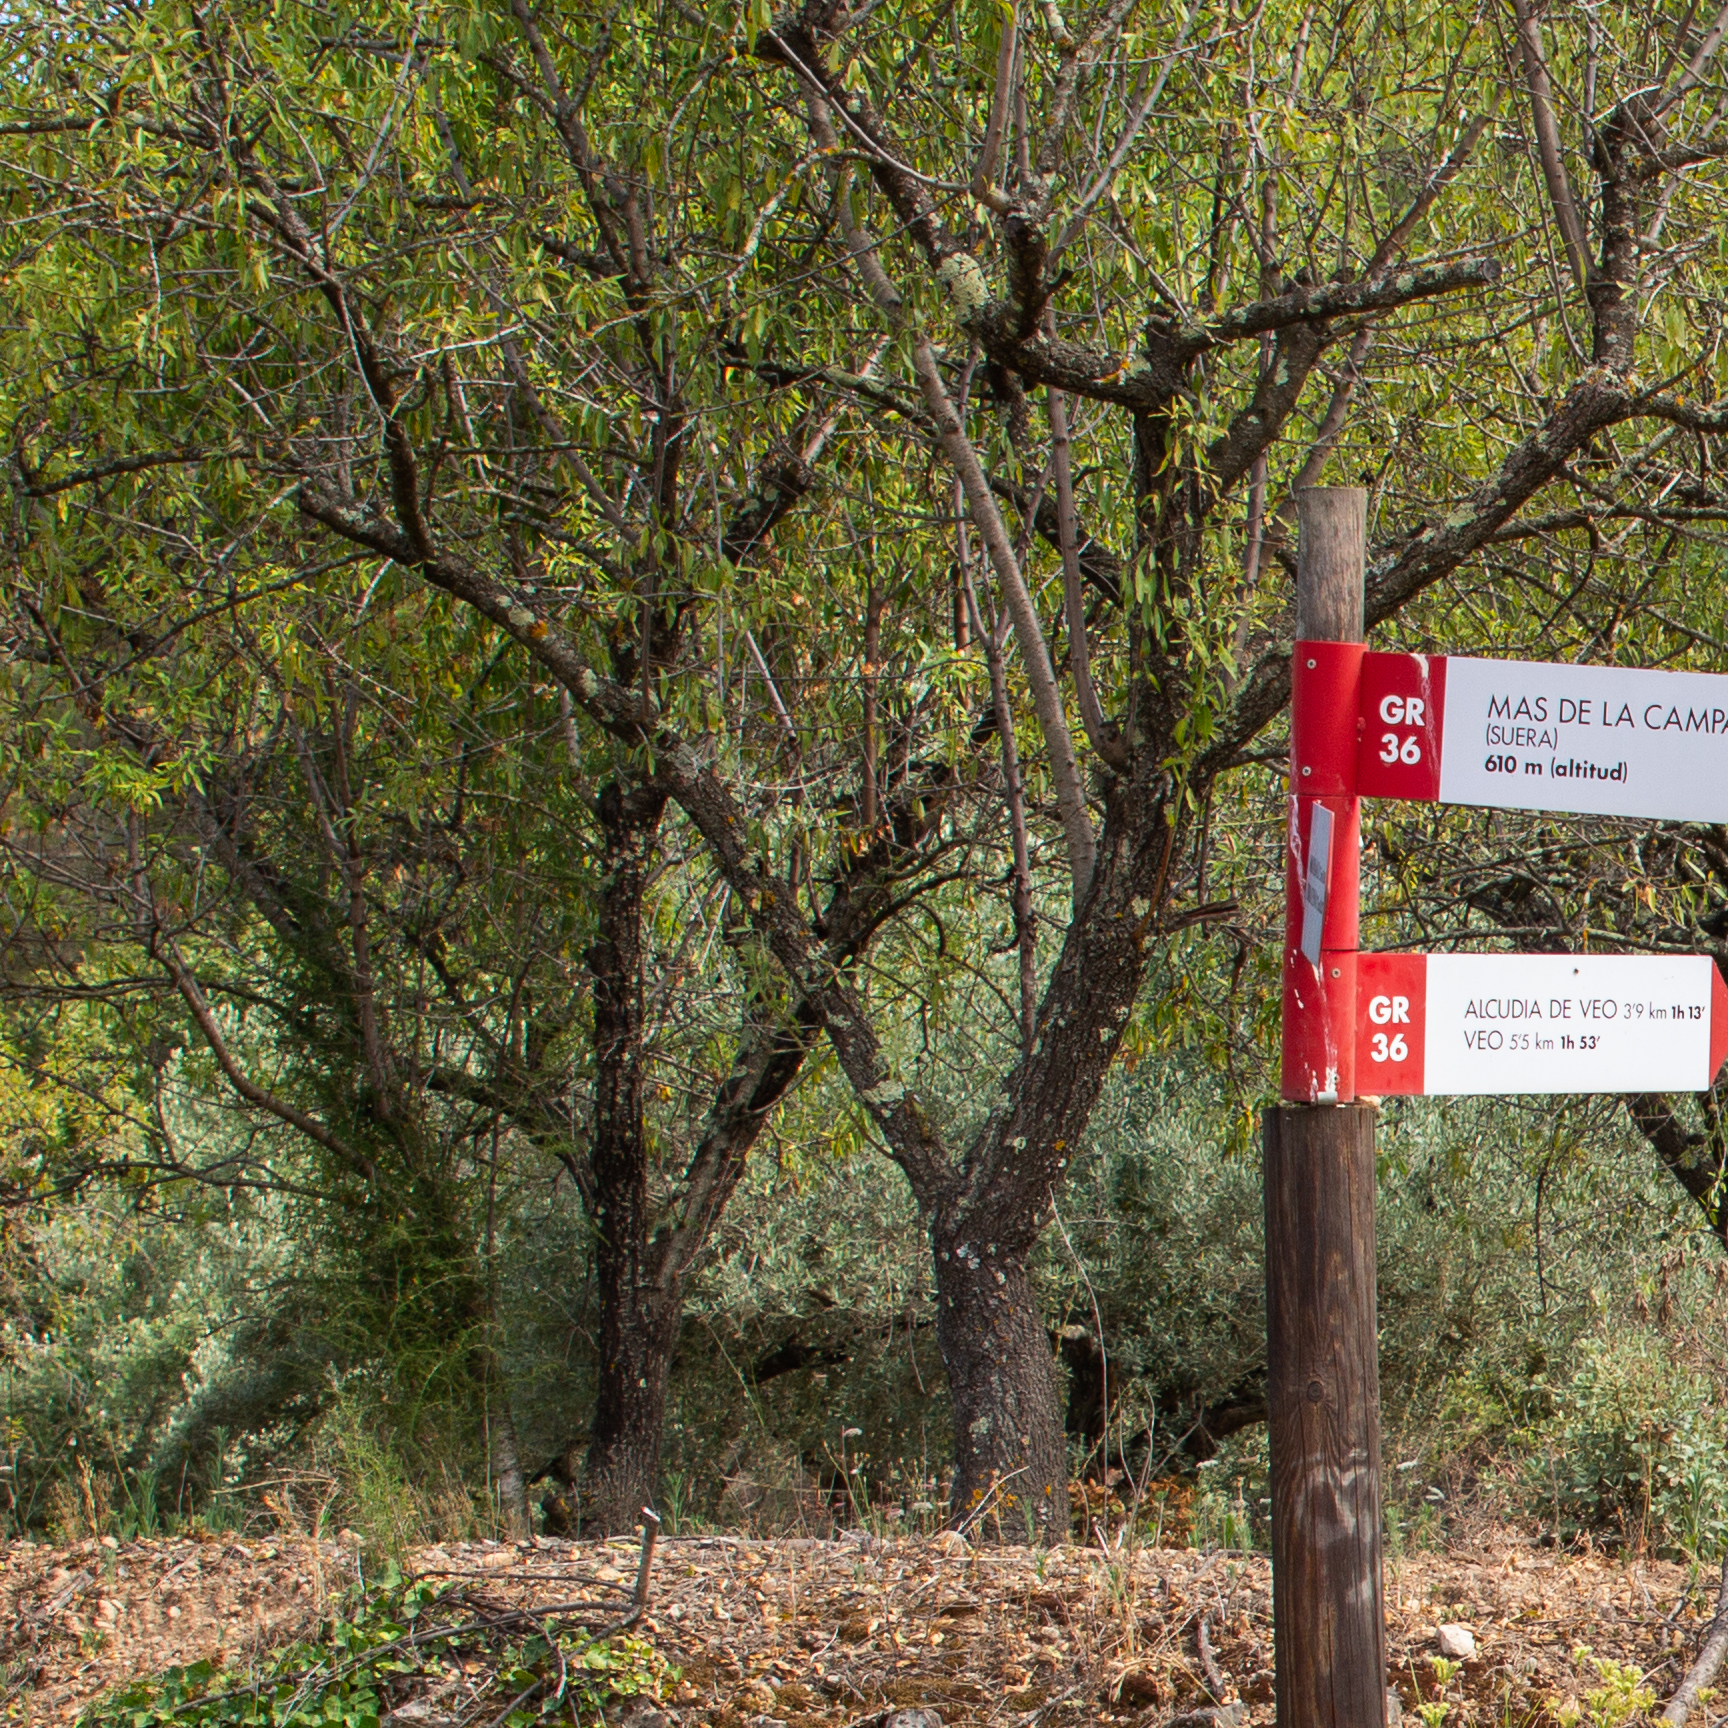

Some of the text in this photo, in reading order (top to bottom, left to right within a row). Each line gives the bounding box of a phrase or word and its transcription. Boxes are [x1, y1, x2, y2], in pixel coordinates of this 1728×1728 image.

[1379, 694, 1426, 727] GR
[1487, 694, 1548, 723] MAS
[1559, 698, 1592, 726] DE
[1602, 701, 1635, 728] LA
[1379, 732, 1422, 765] 36
[1486, 723, 1559, 751] (SUERA)
[1484, 755, 1628, 784] 610 m (altitud)
[1368, 995, 1411, 1025] GR
[1464, 998, 1543, 1019] ALCUDIA
[1549, 999, 1572, 1019] DE
[1579, 999, 1618, 1019] VEO
[1649, 1001, 1668, 1020] km
[1671, 1004, 1685, 1020] 1h
[1370, 1032, 1409, 1063] 36
[1463, 1030, 1504, 1051] VEO
[1535, 1032, 1554, 1050] km
[1560, 1035, 1575, 1050] 1h
